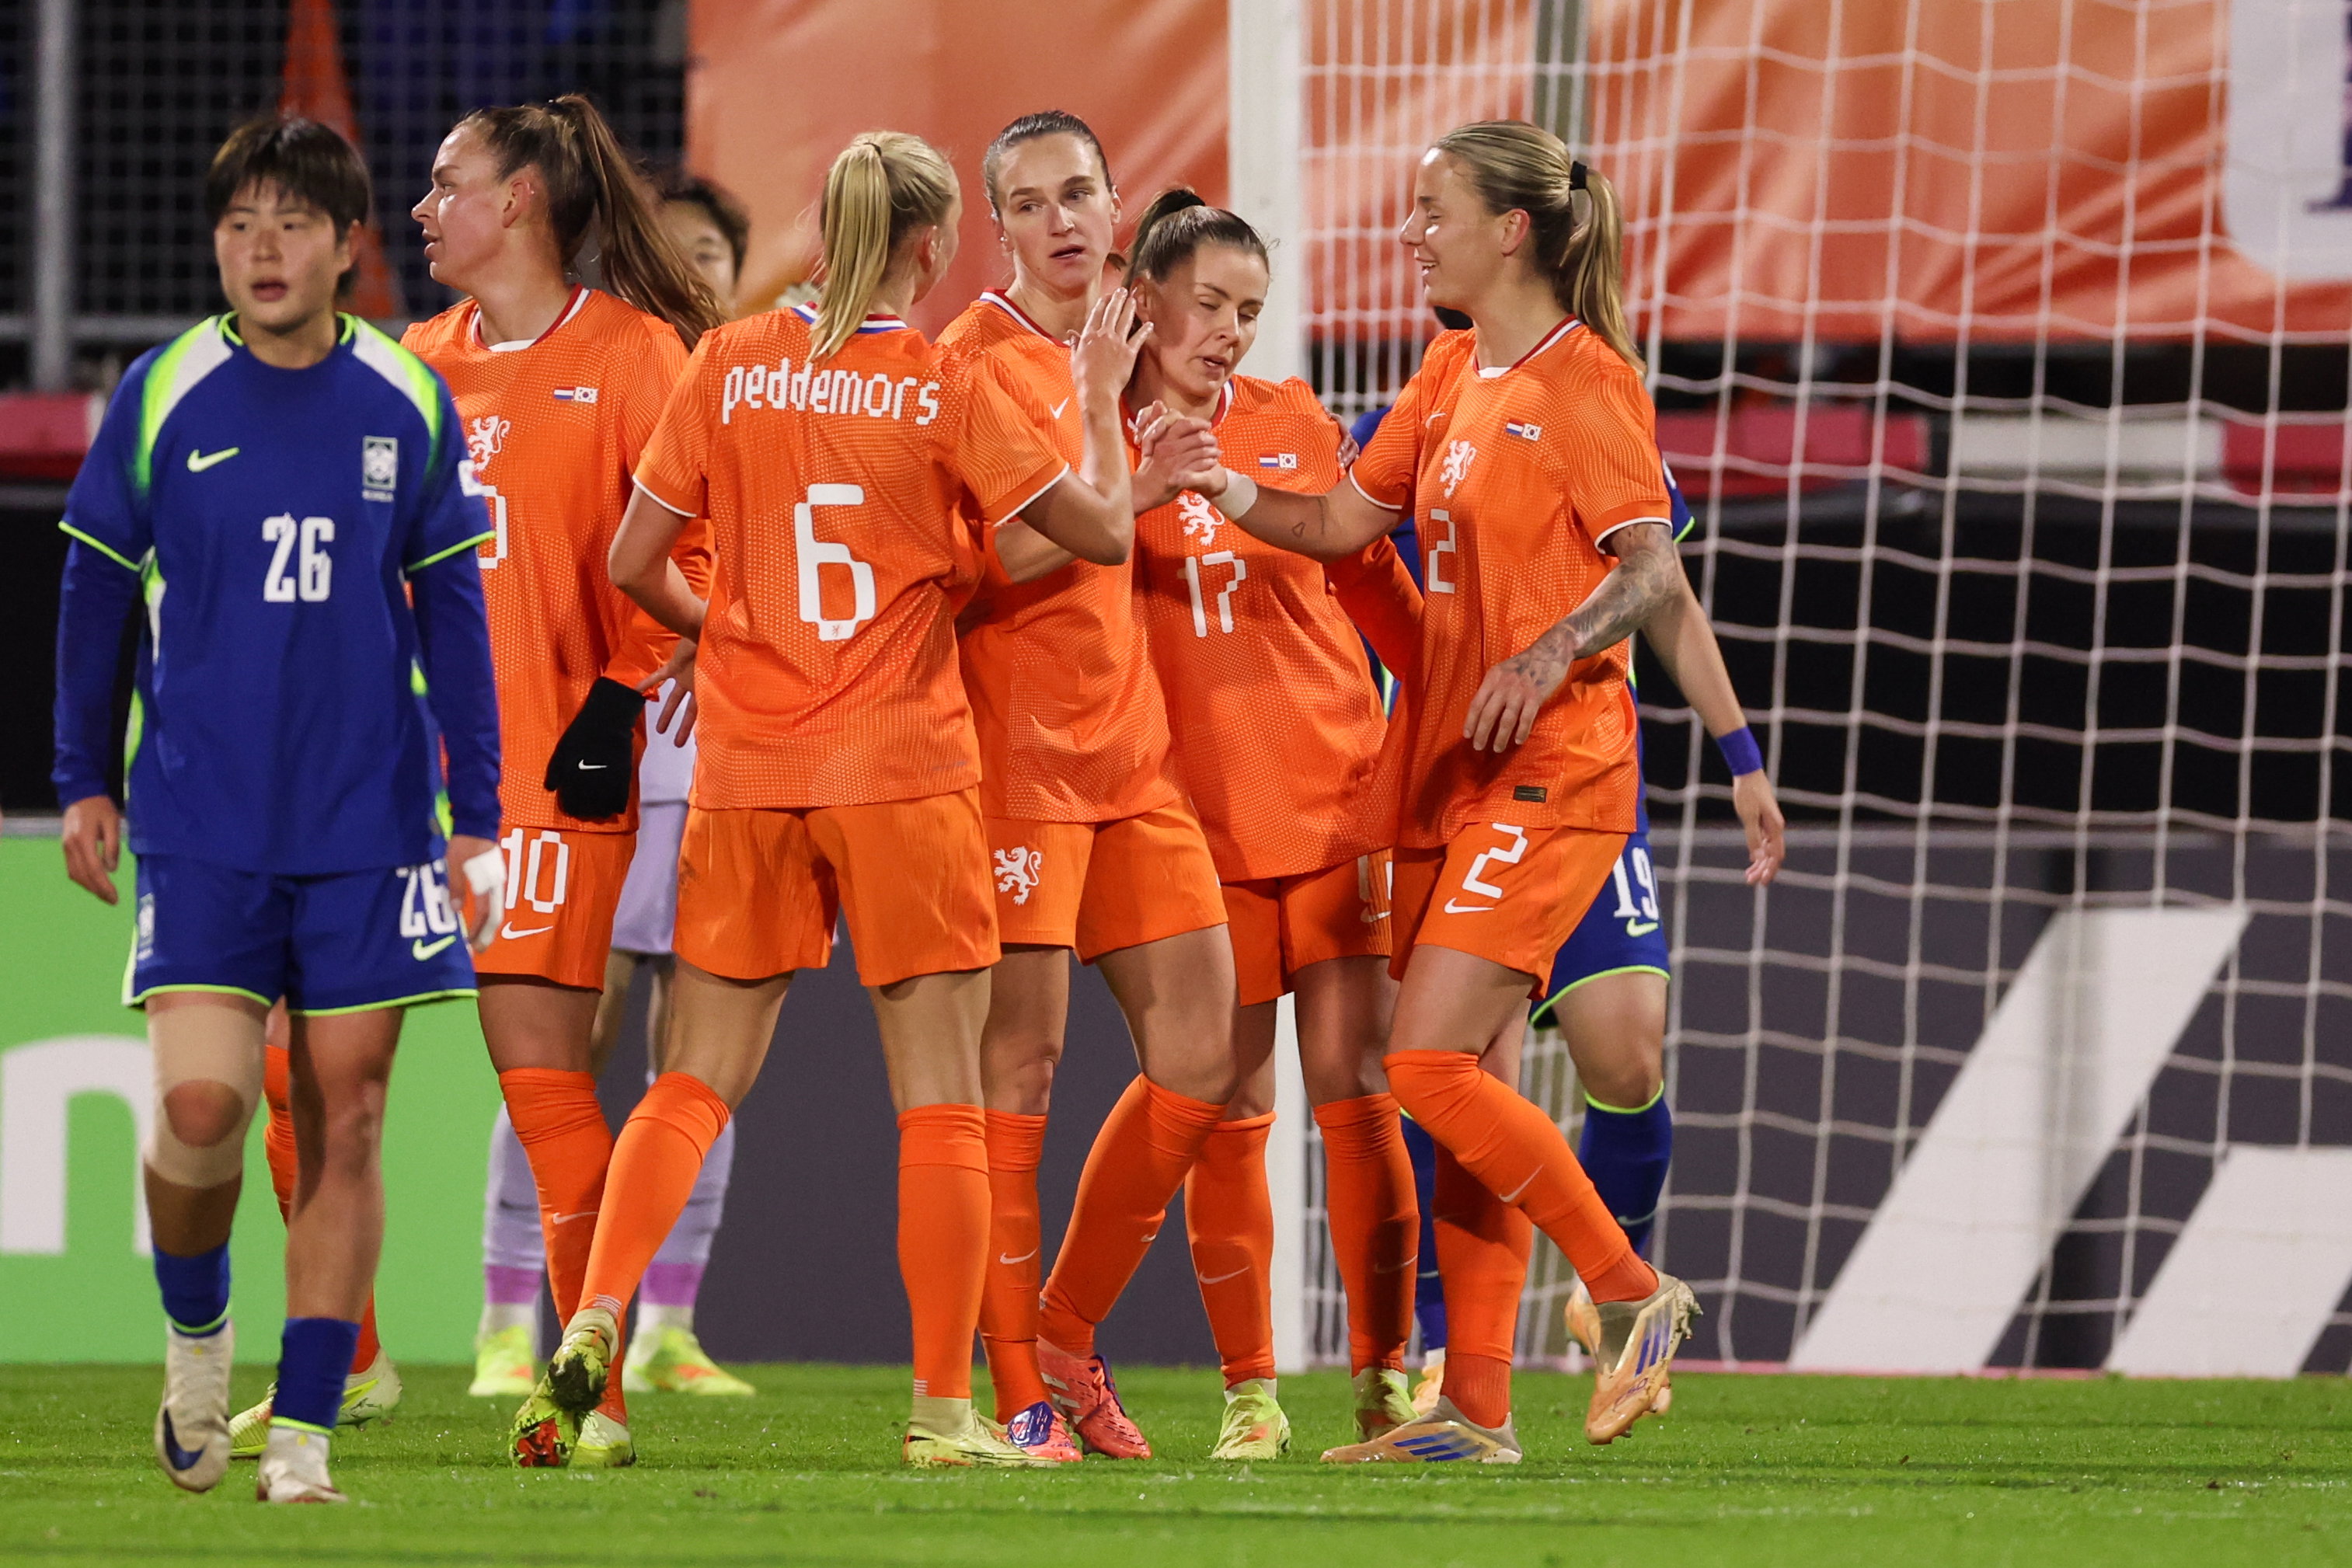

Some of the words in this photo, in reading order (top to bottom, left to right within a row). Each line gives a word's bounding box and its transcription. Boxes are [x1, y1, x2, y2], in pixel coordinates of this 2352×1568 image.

[722, 357, 940, 426] peddemors
[261, 511, 336, 603] 26
[793, 483, 876, 642] 6
[1428, 507, 1456, 594] 2
[1176, 550, 1246, 638] 17
[395, 858, 458, 938] 26
[500, 828, 569, 914] 10
[1462, 822, 1528, 899] 2
[1612, 847, 1659, 921] 19
